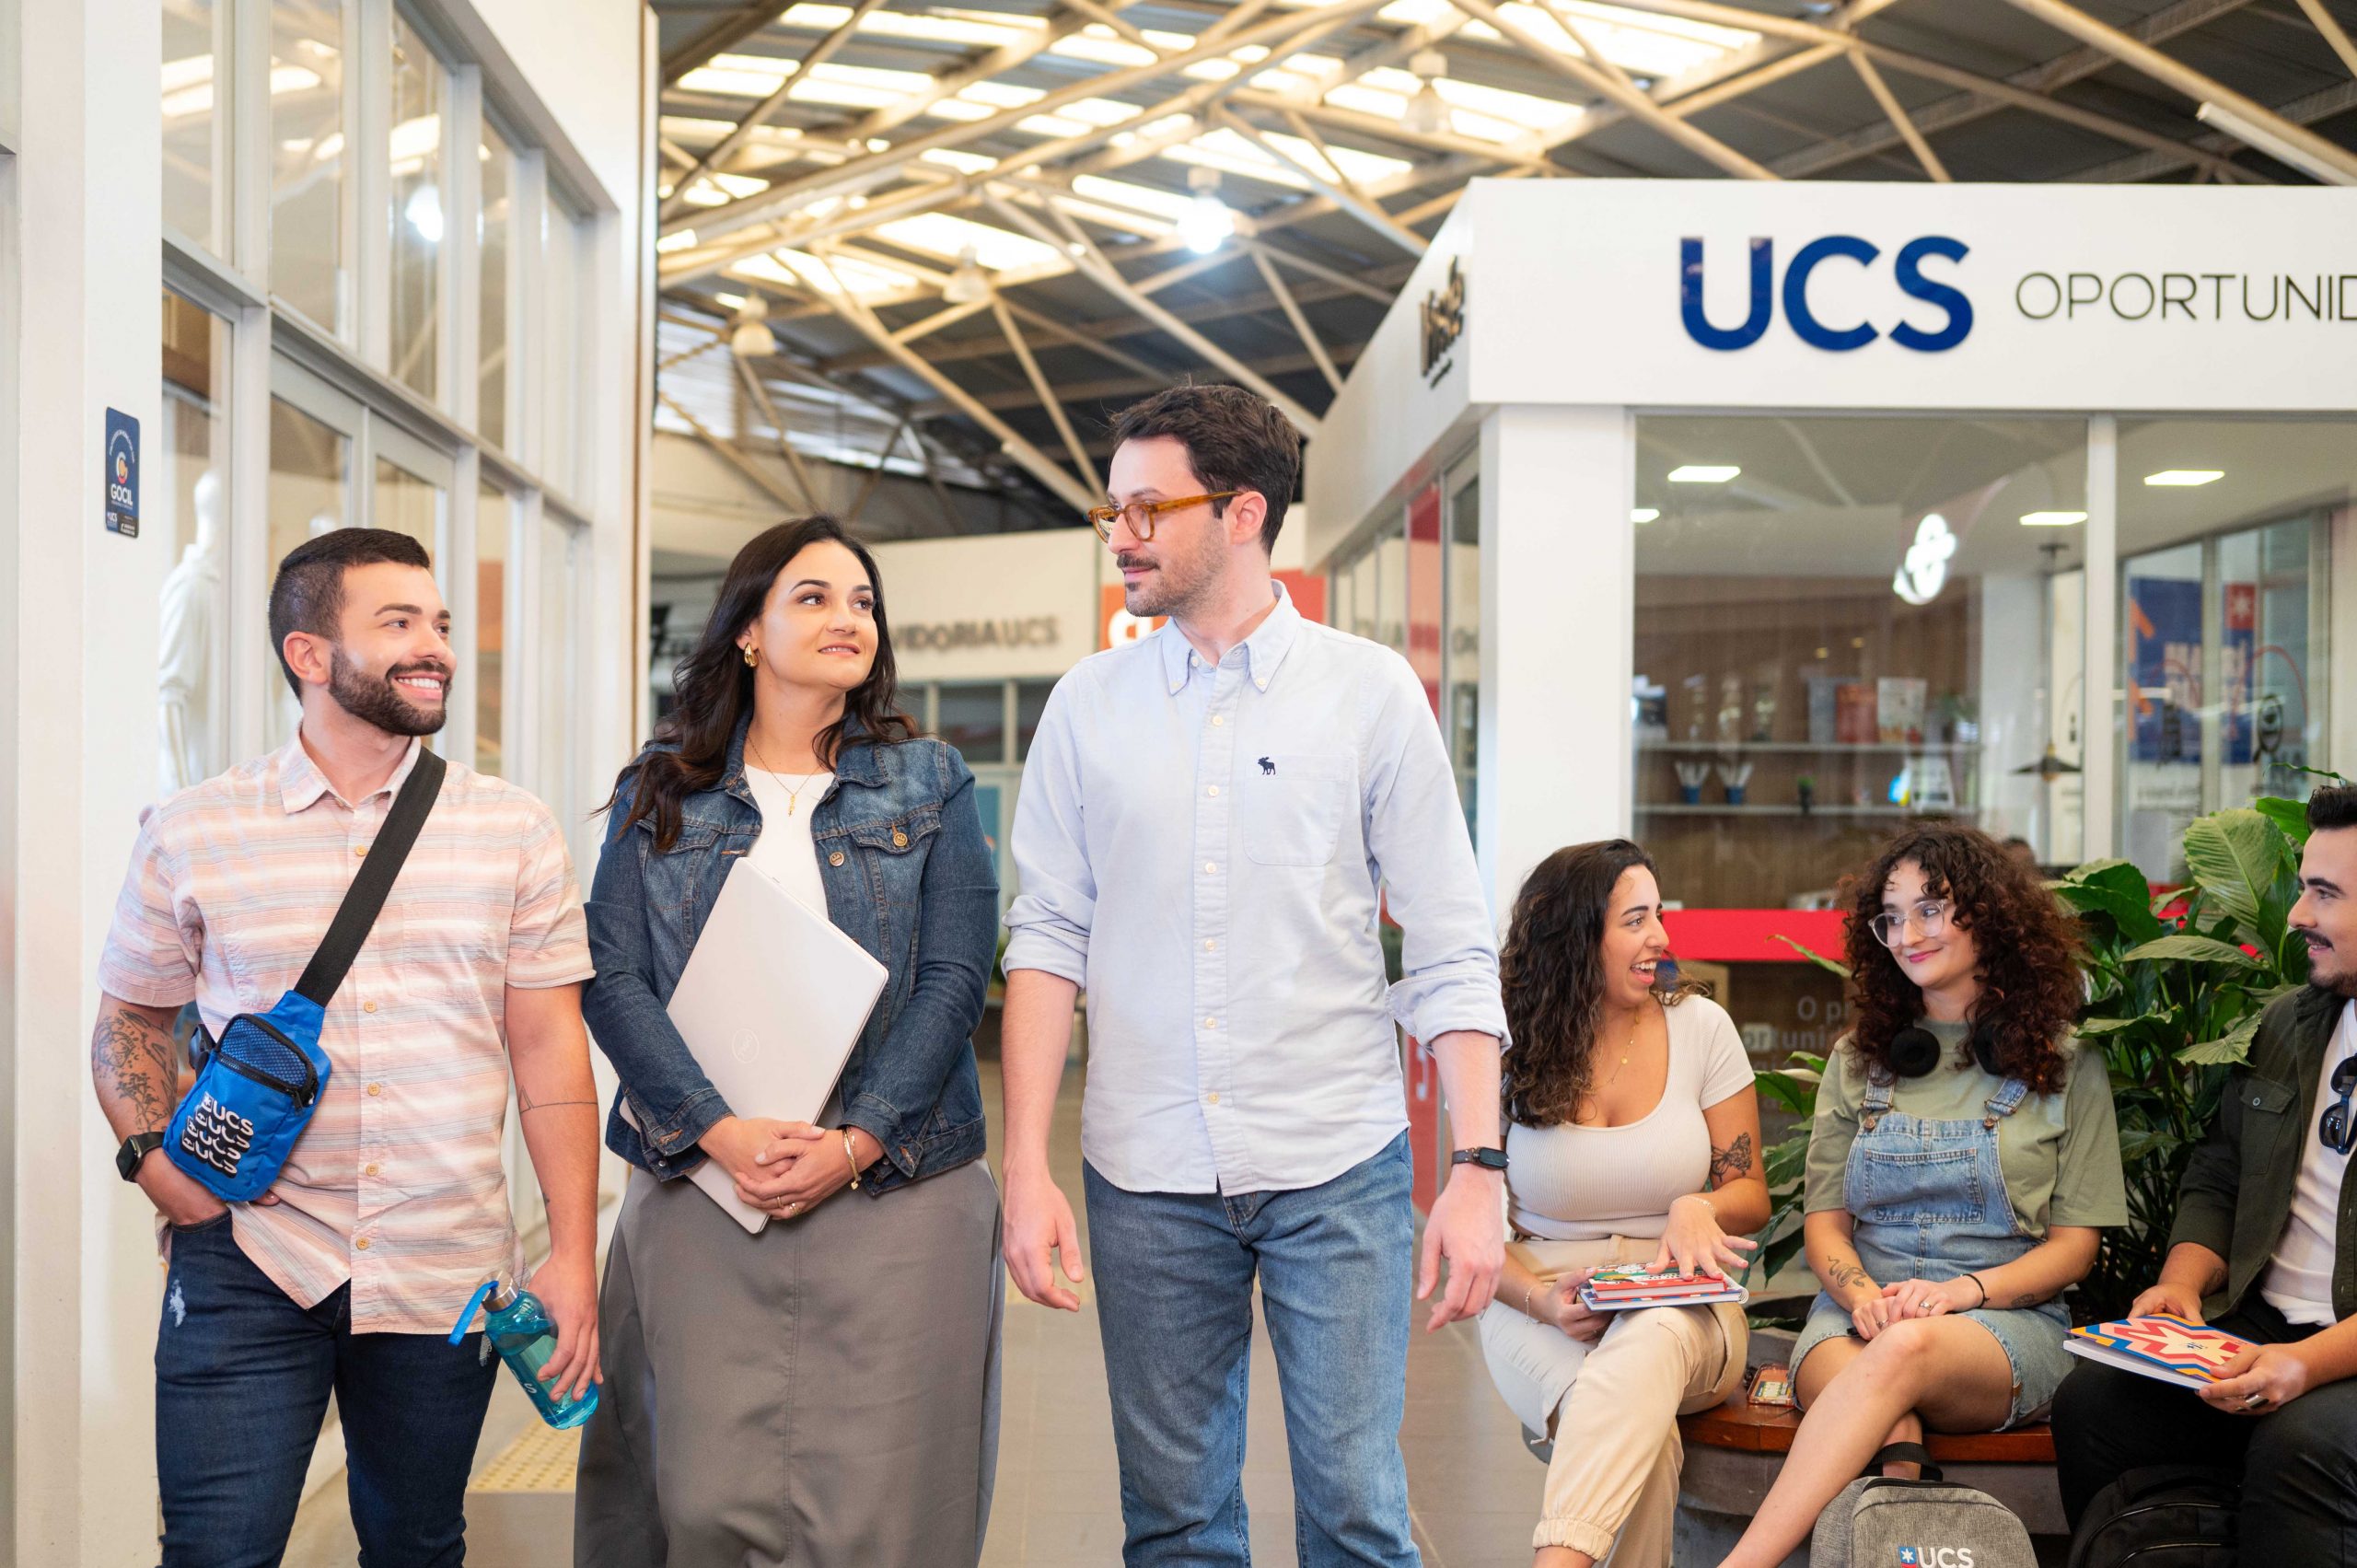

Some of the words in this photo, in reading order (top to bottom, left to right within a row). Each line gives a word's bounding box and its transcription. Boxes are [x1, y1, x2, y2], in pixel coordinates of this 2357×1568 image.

[1680, 234, 1974, 352] UCS
[110, 483, 134, 505] GOCIL
[213, 1099, 254, 1136] UCS
[1917, 1547, 1974, 1568] UCS
